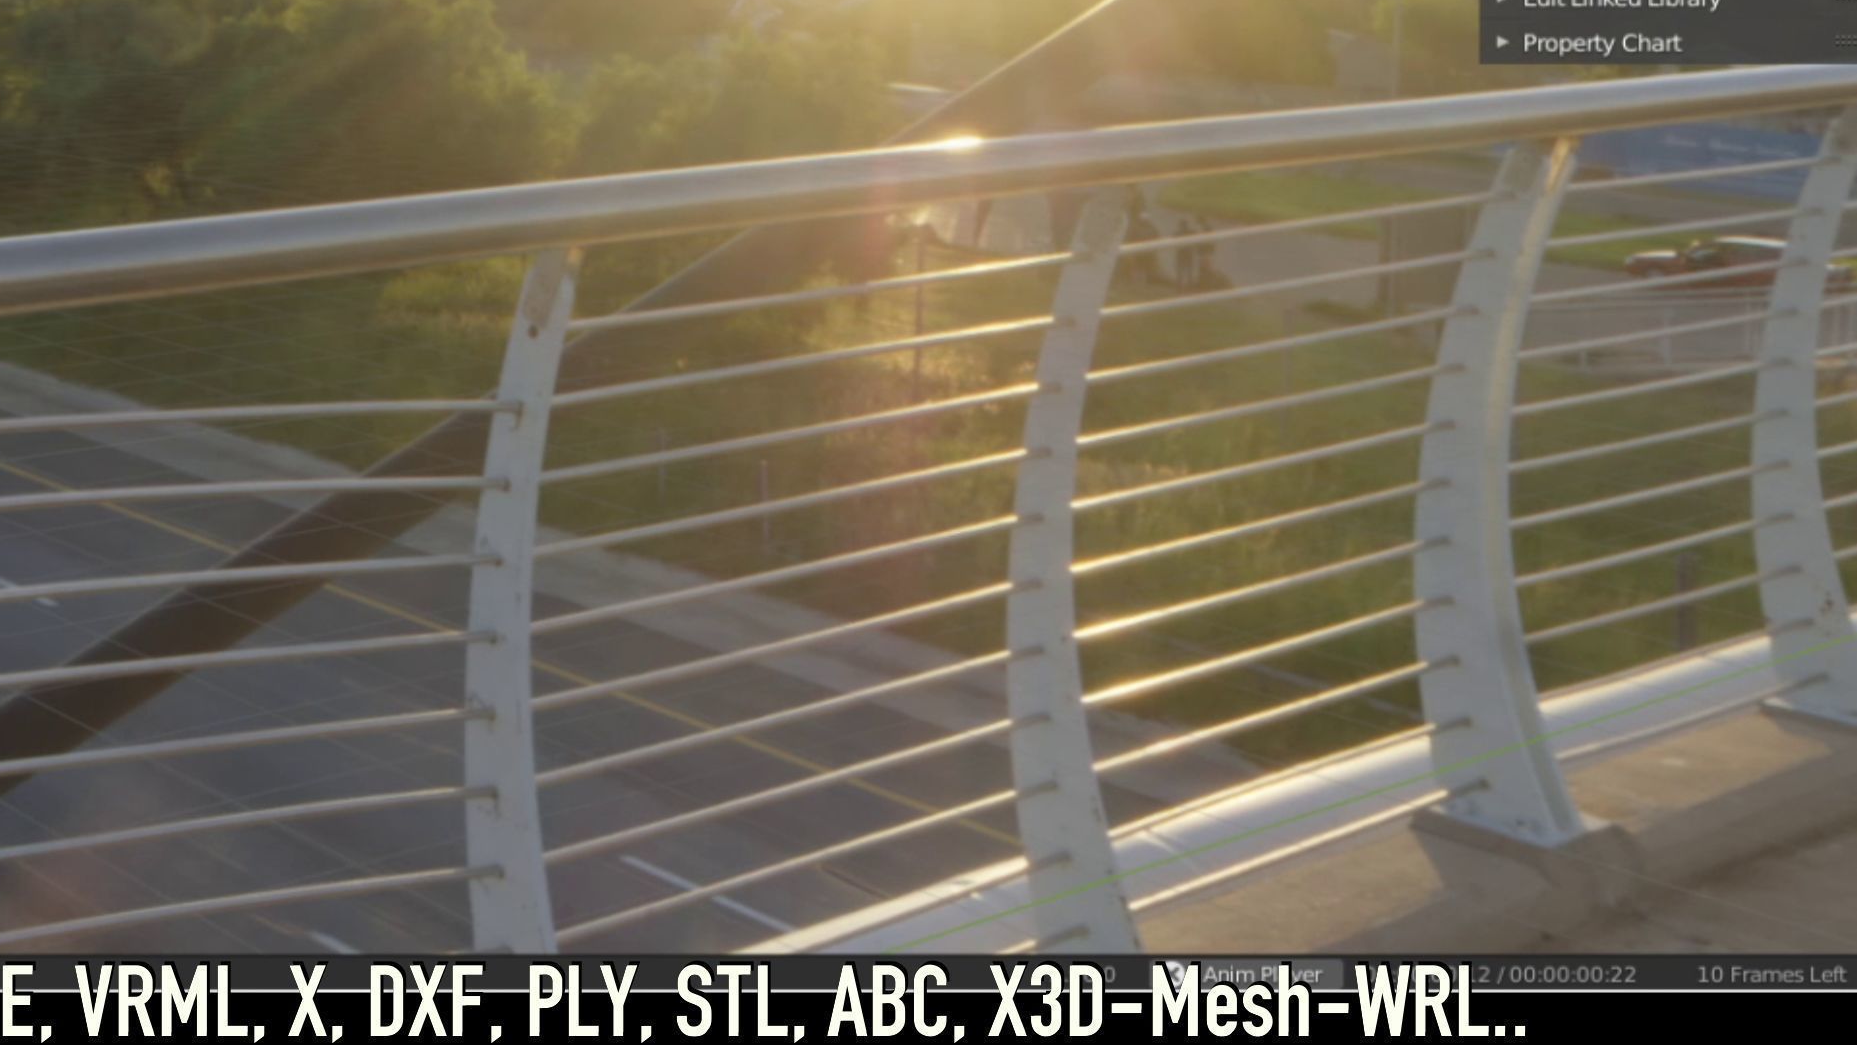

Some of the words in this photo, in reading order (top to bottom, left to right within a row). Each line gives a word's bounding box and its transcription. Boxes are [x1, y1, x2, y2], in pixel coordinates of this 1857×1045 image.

[1524, 33, 1615, 57] Property
[1622, 33, 1683, 53] Chart
[1204, 966, 1255, 983] Anim
[1261, 966, 1323, 987] Plyer
[1510, 966, 1637, 984] 00:00:00:22
[1698, 966, 1724, 983] 10
[1731, 966, 1804, 983] Frames
[1810, 965, 1848, 983] Left
